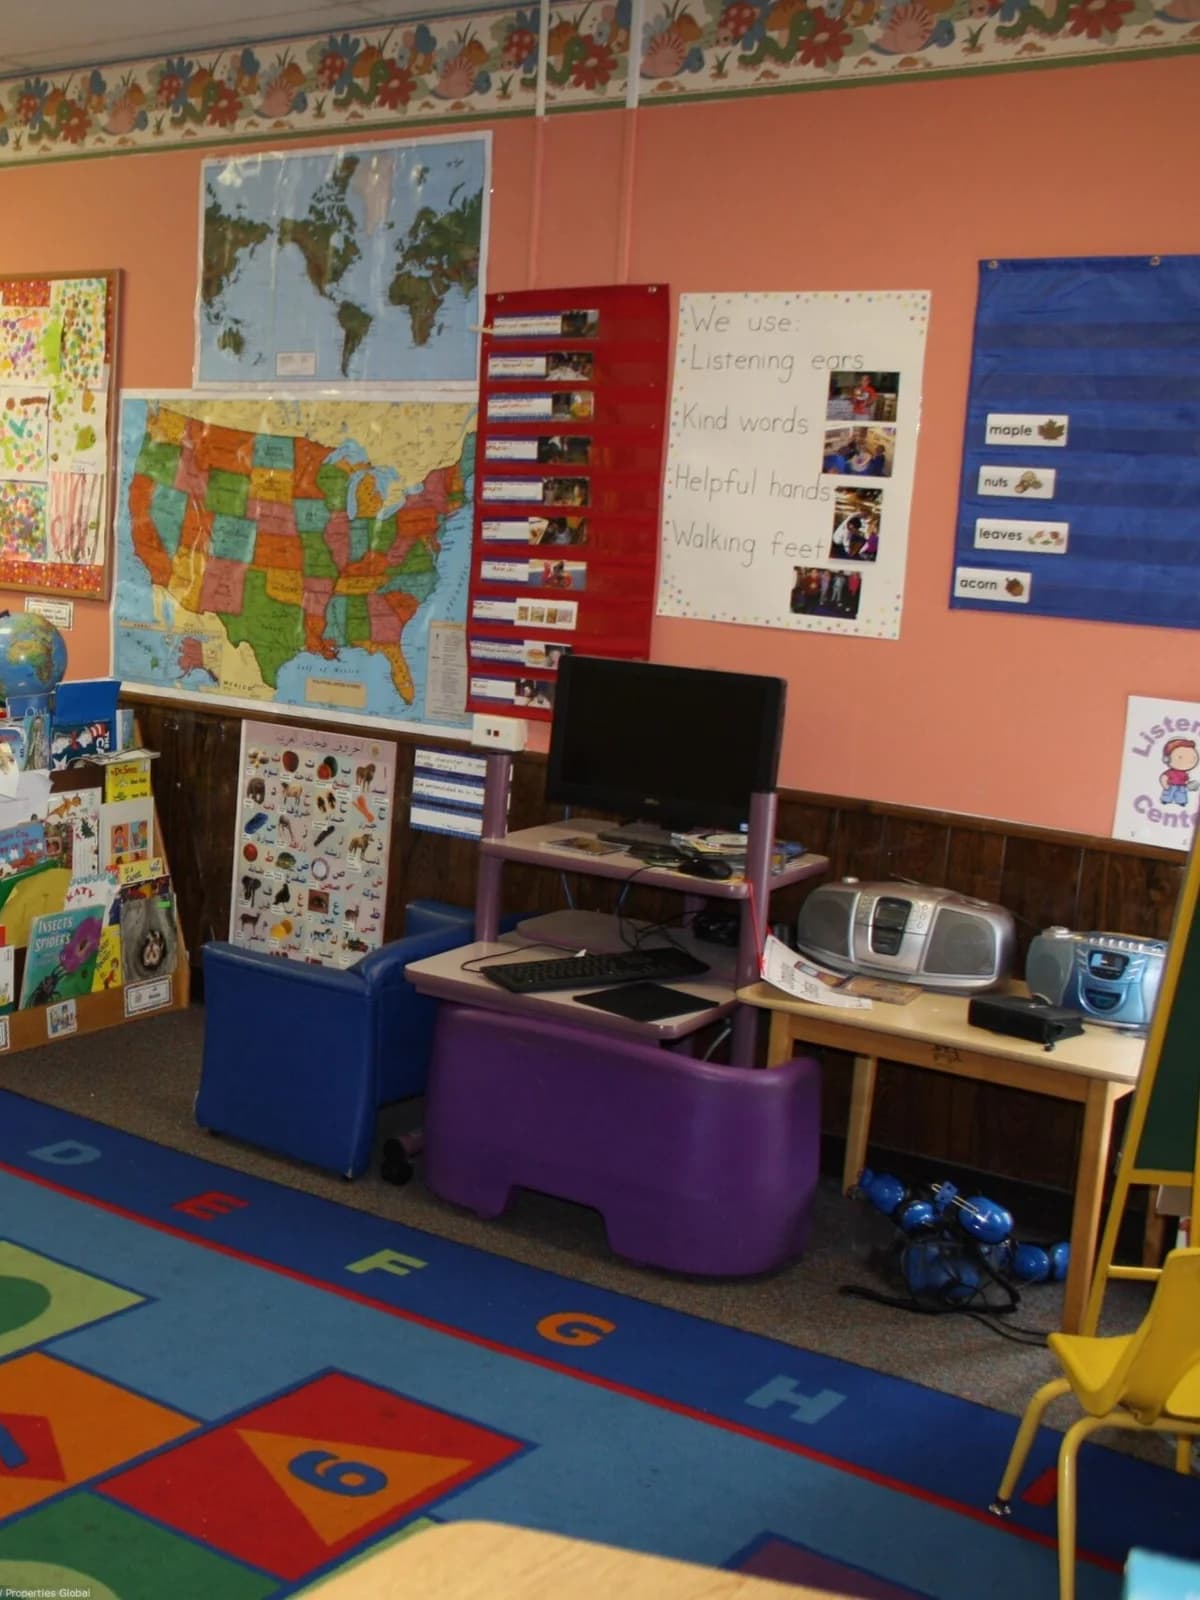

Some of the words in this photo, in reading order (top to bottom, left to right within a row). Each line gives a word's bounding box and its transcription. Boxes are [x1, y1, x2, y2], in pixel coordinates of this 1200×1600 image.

[690, 304, 730, 333] We
[749, 315, 801, 333] use:
[690, 345, 795, 384] Listening
[811, 351, 865, 370] ears
[682, 402, 729, 431] Kind
[740, 406, 809, 435] words
[989, 423, 1033, 438] maple
[675, 464, 757, 502] Helpful
[770, 472, 832, 502] hands
[984, 476, 1009, 488] nuts
[671, 518, 756, 568] Walking
[771, 530, 826, 560] feet
[979, 527, 1023, 542] leaves
[959, 577, 998, 591] acorn
[66, 886, 96, 903] KATY
[38, 915, 74, 933] INSECTS
[34, 933, 72, 953] SPIDERS
[27, 1139, 102, 1166] D
[171, 1189, 250, 1222] E
[343, 1248, 429, 1276] F
[535, 1311, 616, 1347] G
[744, 1374, 848, 1425] H
[287, 1450, 389, 1497] 6
